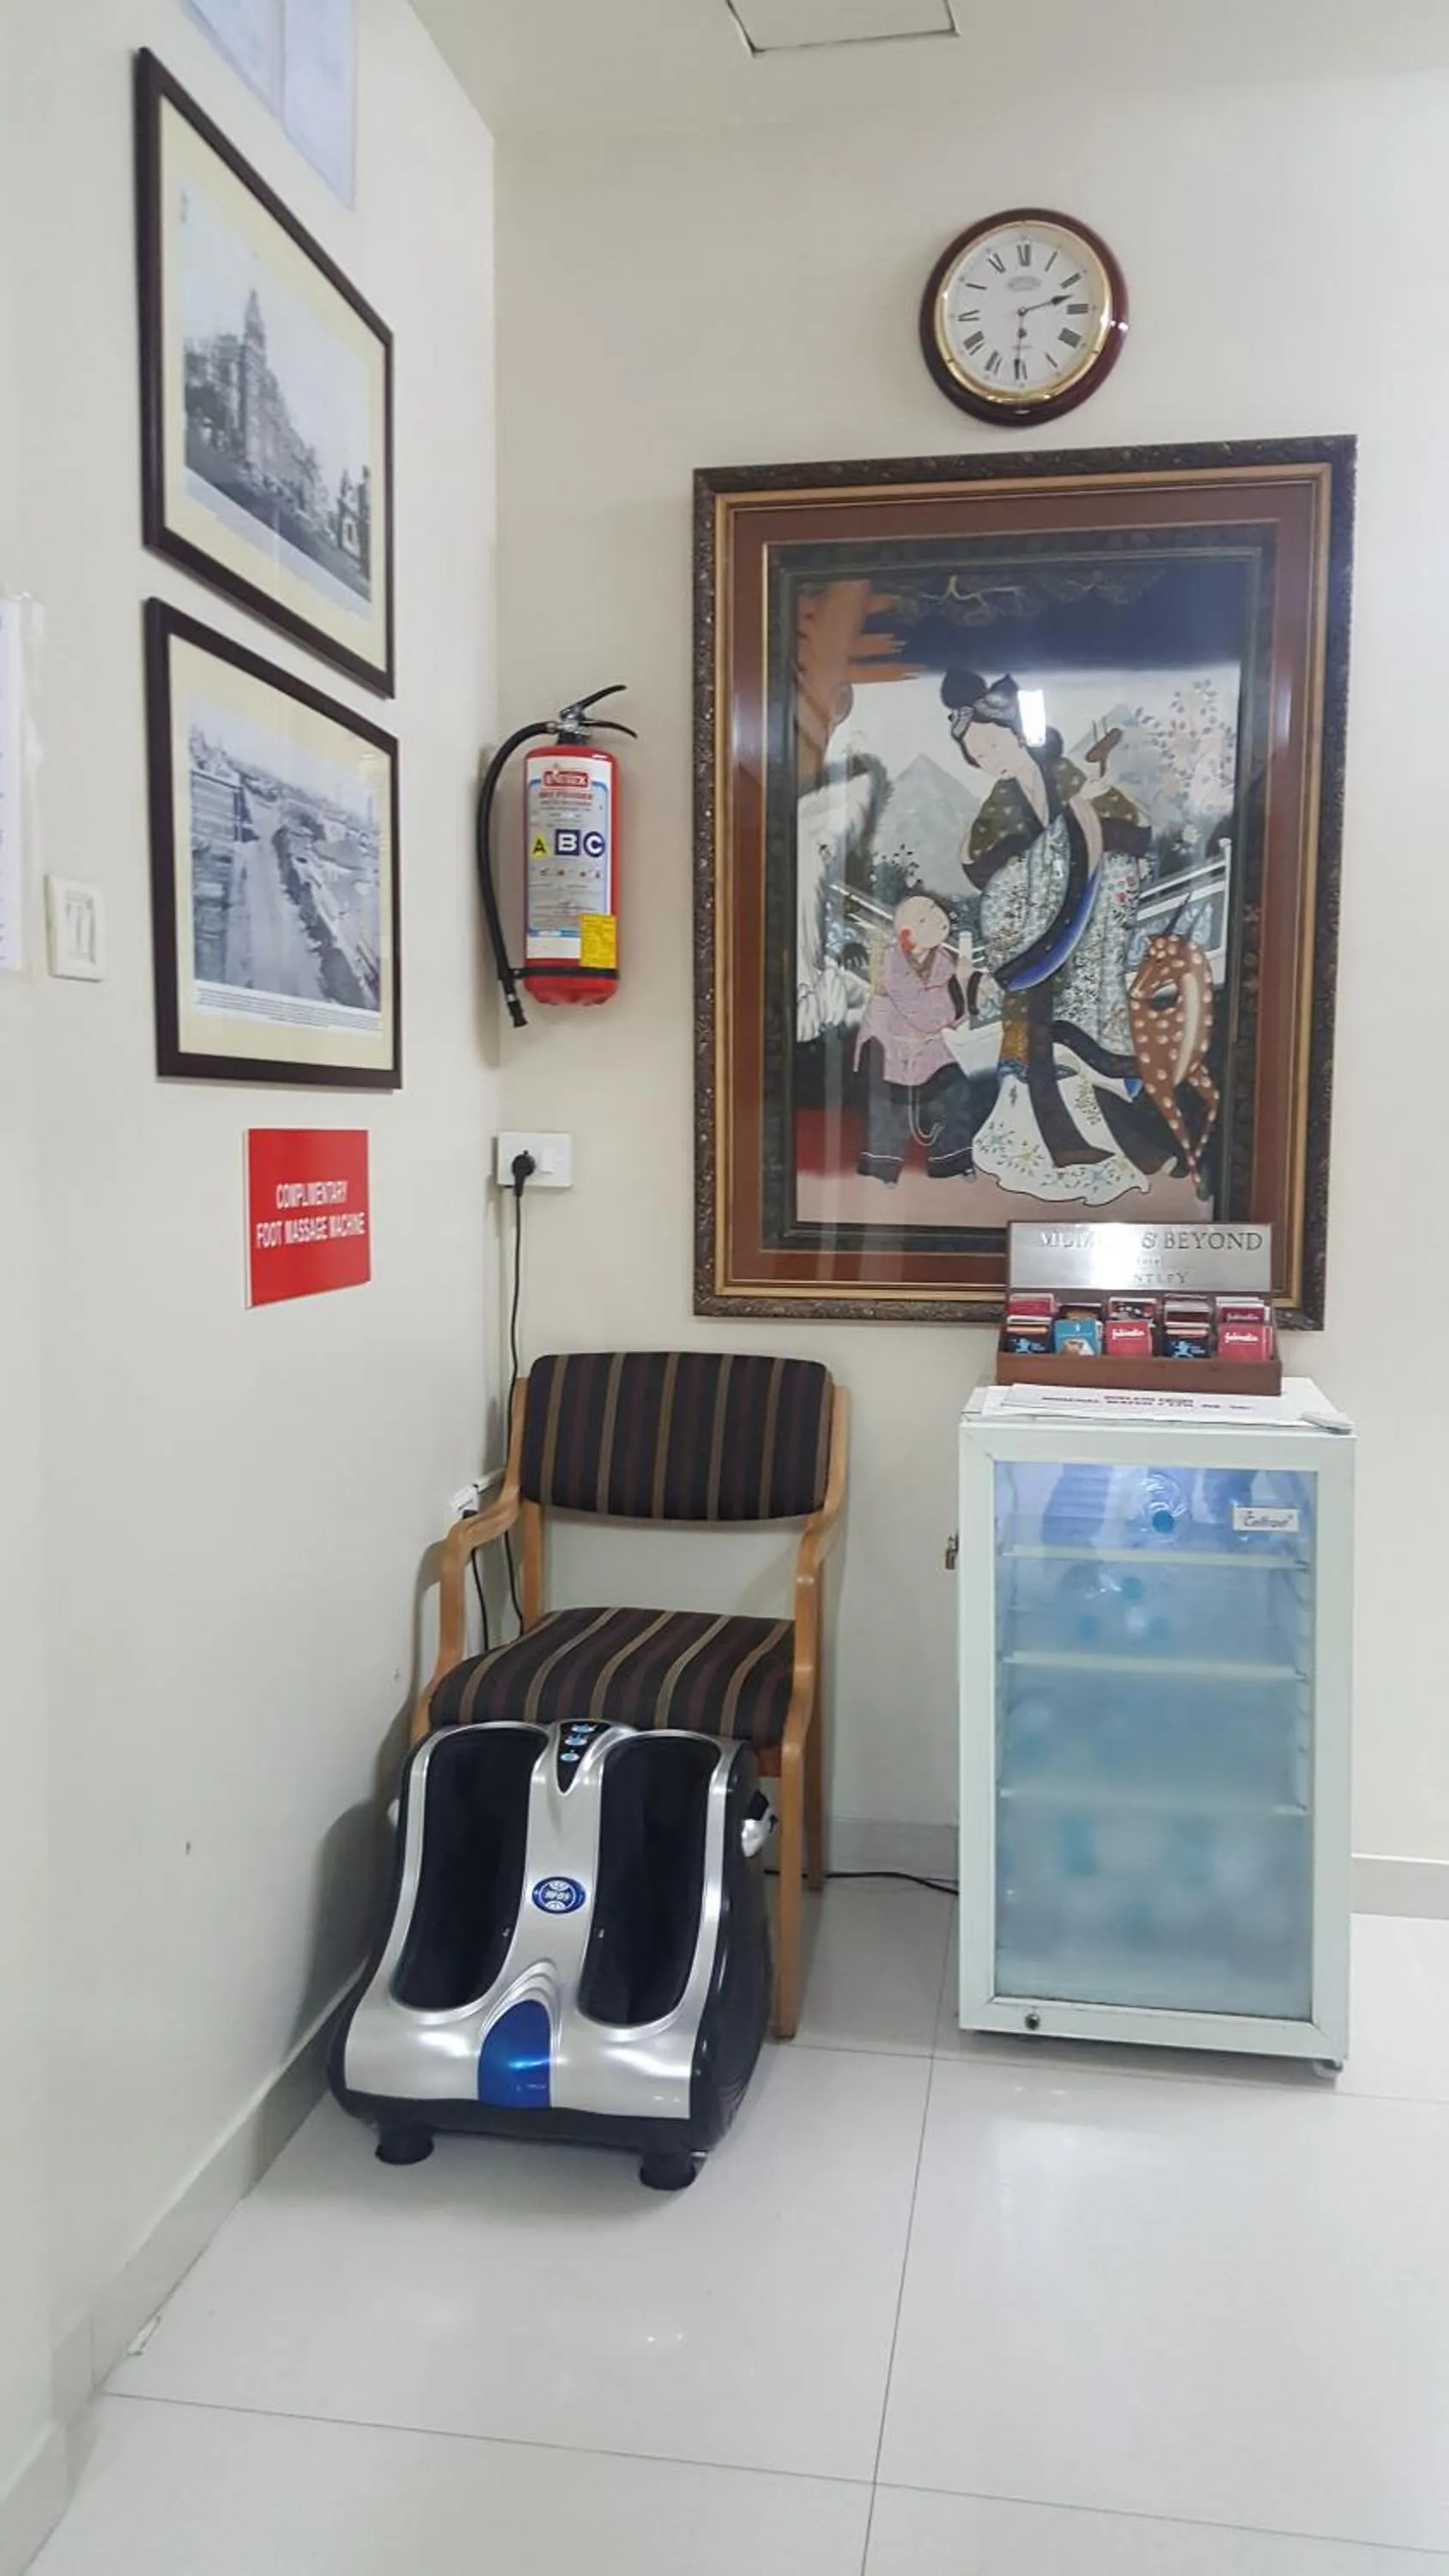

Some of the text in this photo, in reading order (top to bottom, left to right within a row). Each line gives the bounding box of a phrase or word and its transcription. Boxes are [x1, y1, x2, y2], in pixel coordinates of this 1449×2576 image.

[532, 833, 605, 855] A B C
[276, 1181, 348, 1209] COMPLIMENTARY
[257, 1212, 365, 1248] FOOT MASSAGE MACHINE
[1142, 1231, 1156, 1249] &
[1164, 1231, 1263, 1251] BEYOND
[1123, 1272, 1190, 1285] NTLEY
